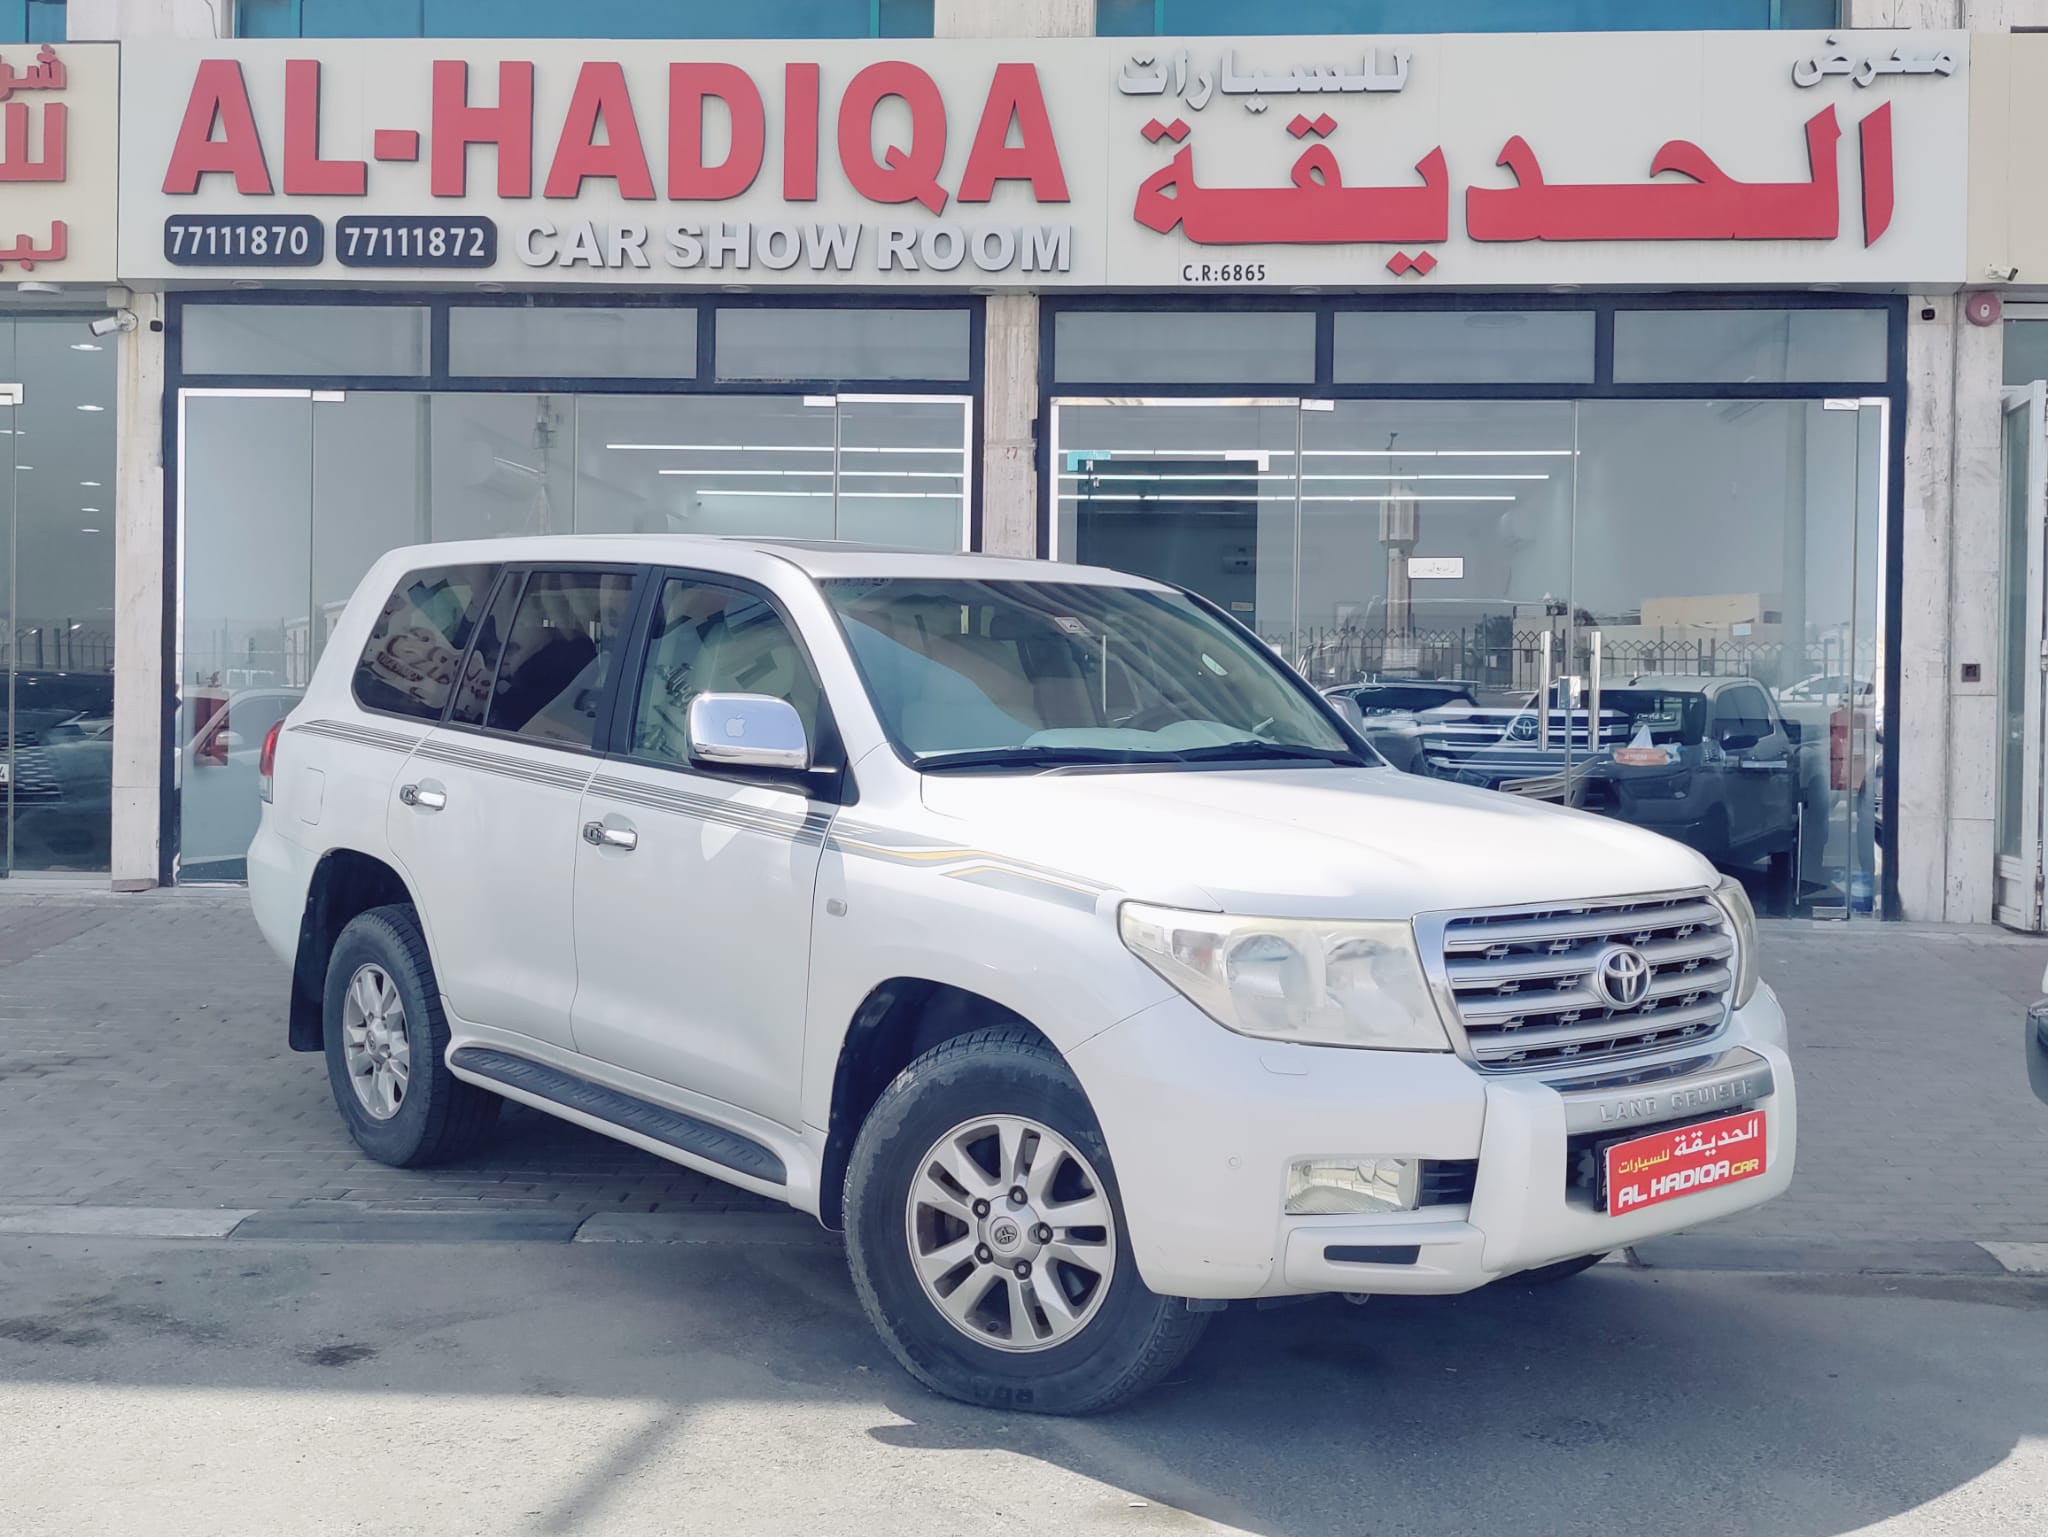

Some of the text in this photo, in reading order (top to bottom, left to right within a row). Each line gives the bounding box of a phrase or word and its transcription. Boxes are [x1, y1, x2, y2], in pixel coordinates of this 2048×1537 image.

[1118, 48, 1413, 113] للسيارات
[1792, 35, 1958, 88] معرض
[161, 58, 1071, 217] AL-HADIQA
[1133, 100, 1895, 276] الحديقة
[170, 226, 485, 257] 77111870 77111872
[515, 220, 1072, 272] CAR SHOW ROOM
[1183, 264, 1265, 281] C.R:6865
[1600, 1079, 1752, 1123] LAND CRUISER
[1618, 1117, 1759, 1175] الحديقة للسيارات
[1618, 1158, 1760, 1209] AL HADIQA CAR
